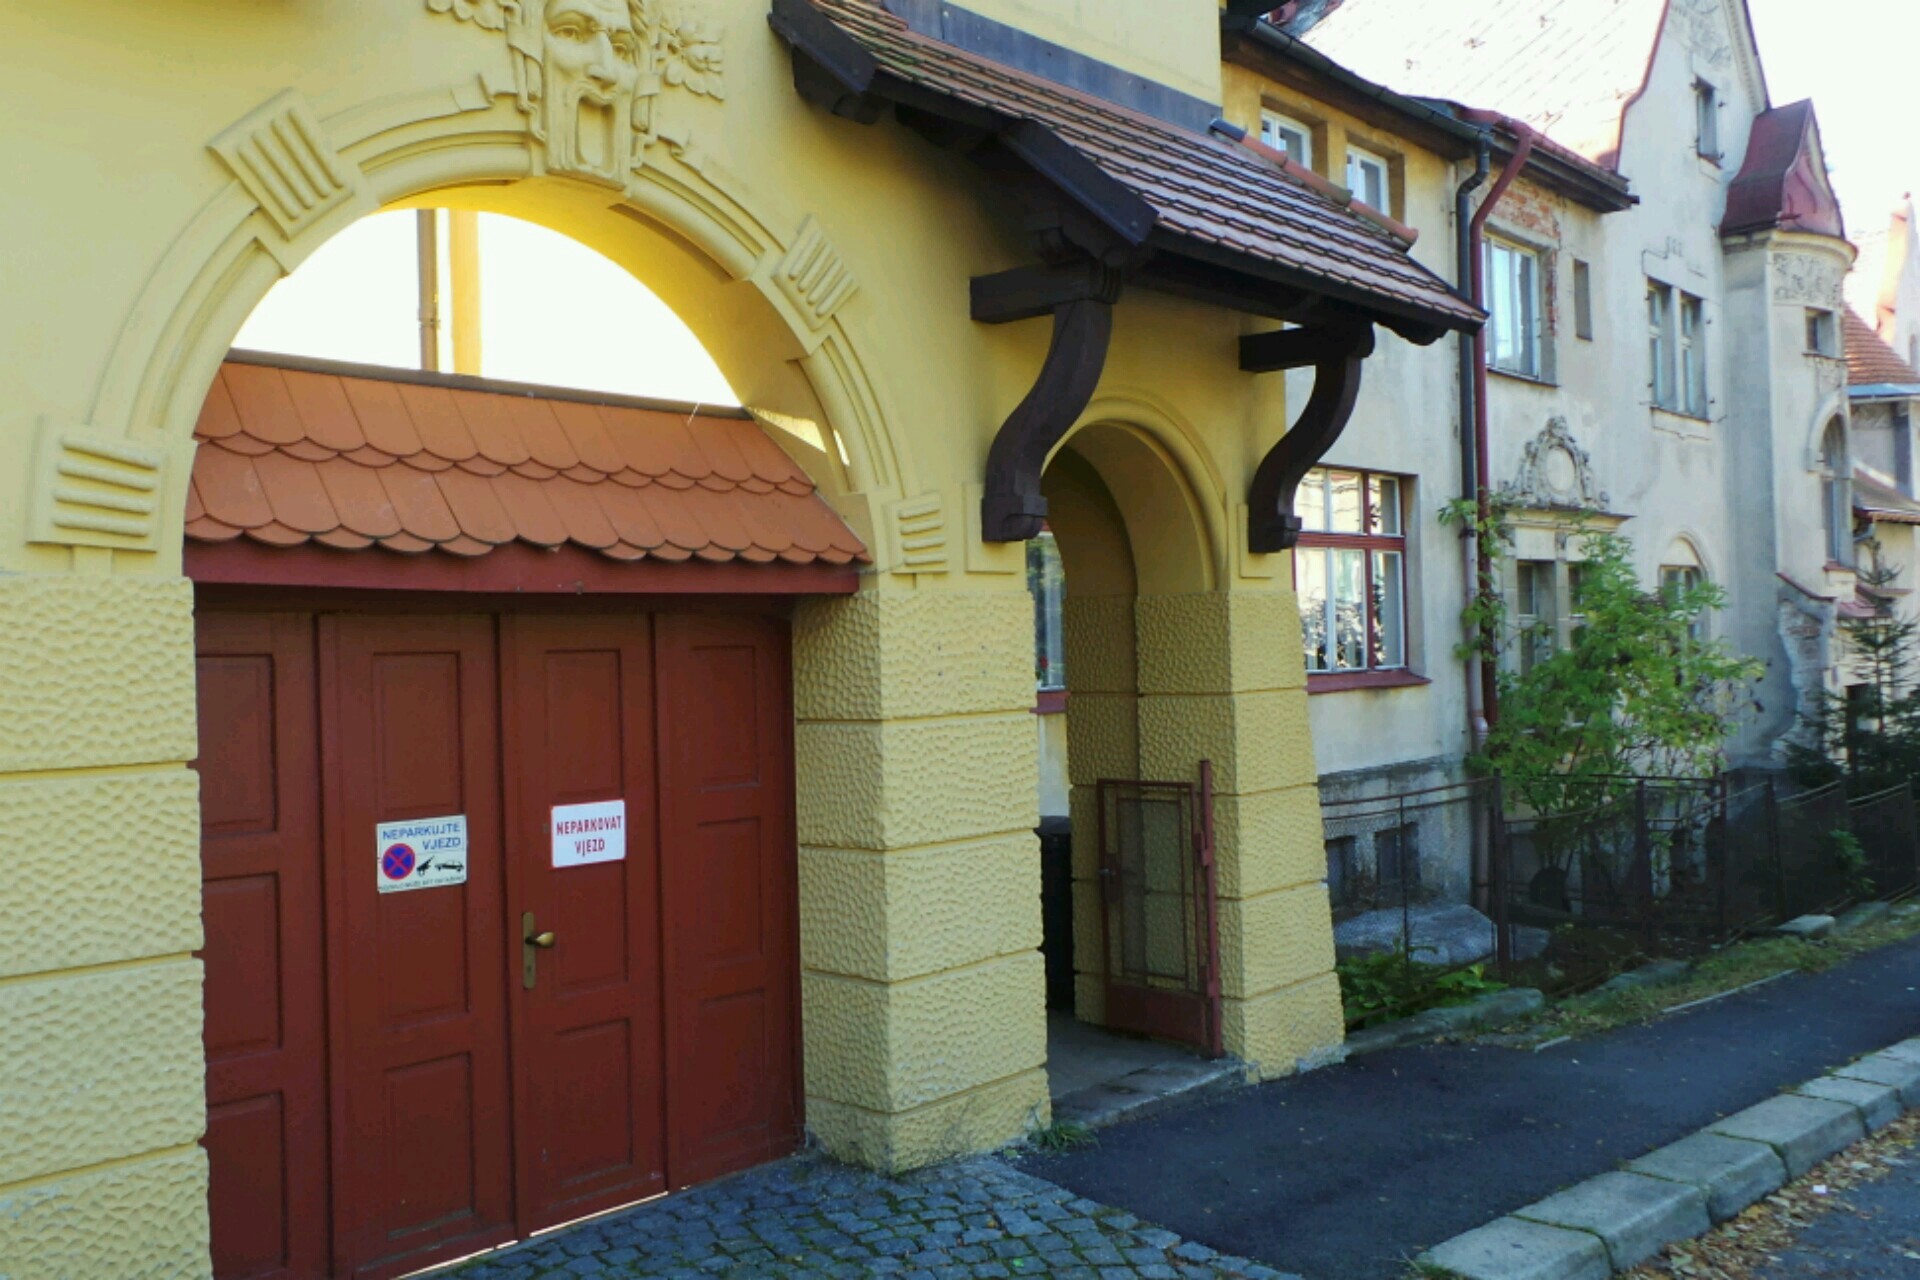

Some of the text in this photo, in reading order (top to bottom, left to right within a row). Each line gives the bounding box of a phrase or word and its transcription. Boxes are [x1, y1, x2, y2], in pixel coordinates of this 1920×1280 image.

[382, 823, 461, 840] NEPARKUJTE
[556, 815, 621, 836] NEPARKOVAT
[422, 837, 461, 850] VJEZD
[574, 838, 605, 857] VJEZD
